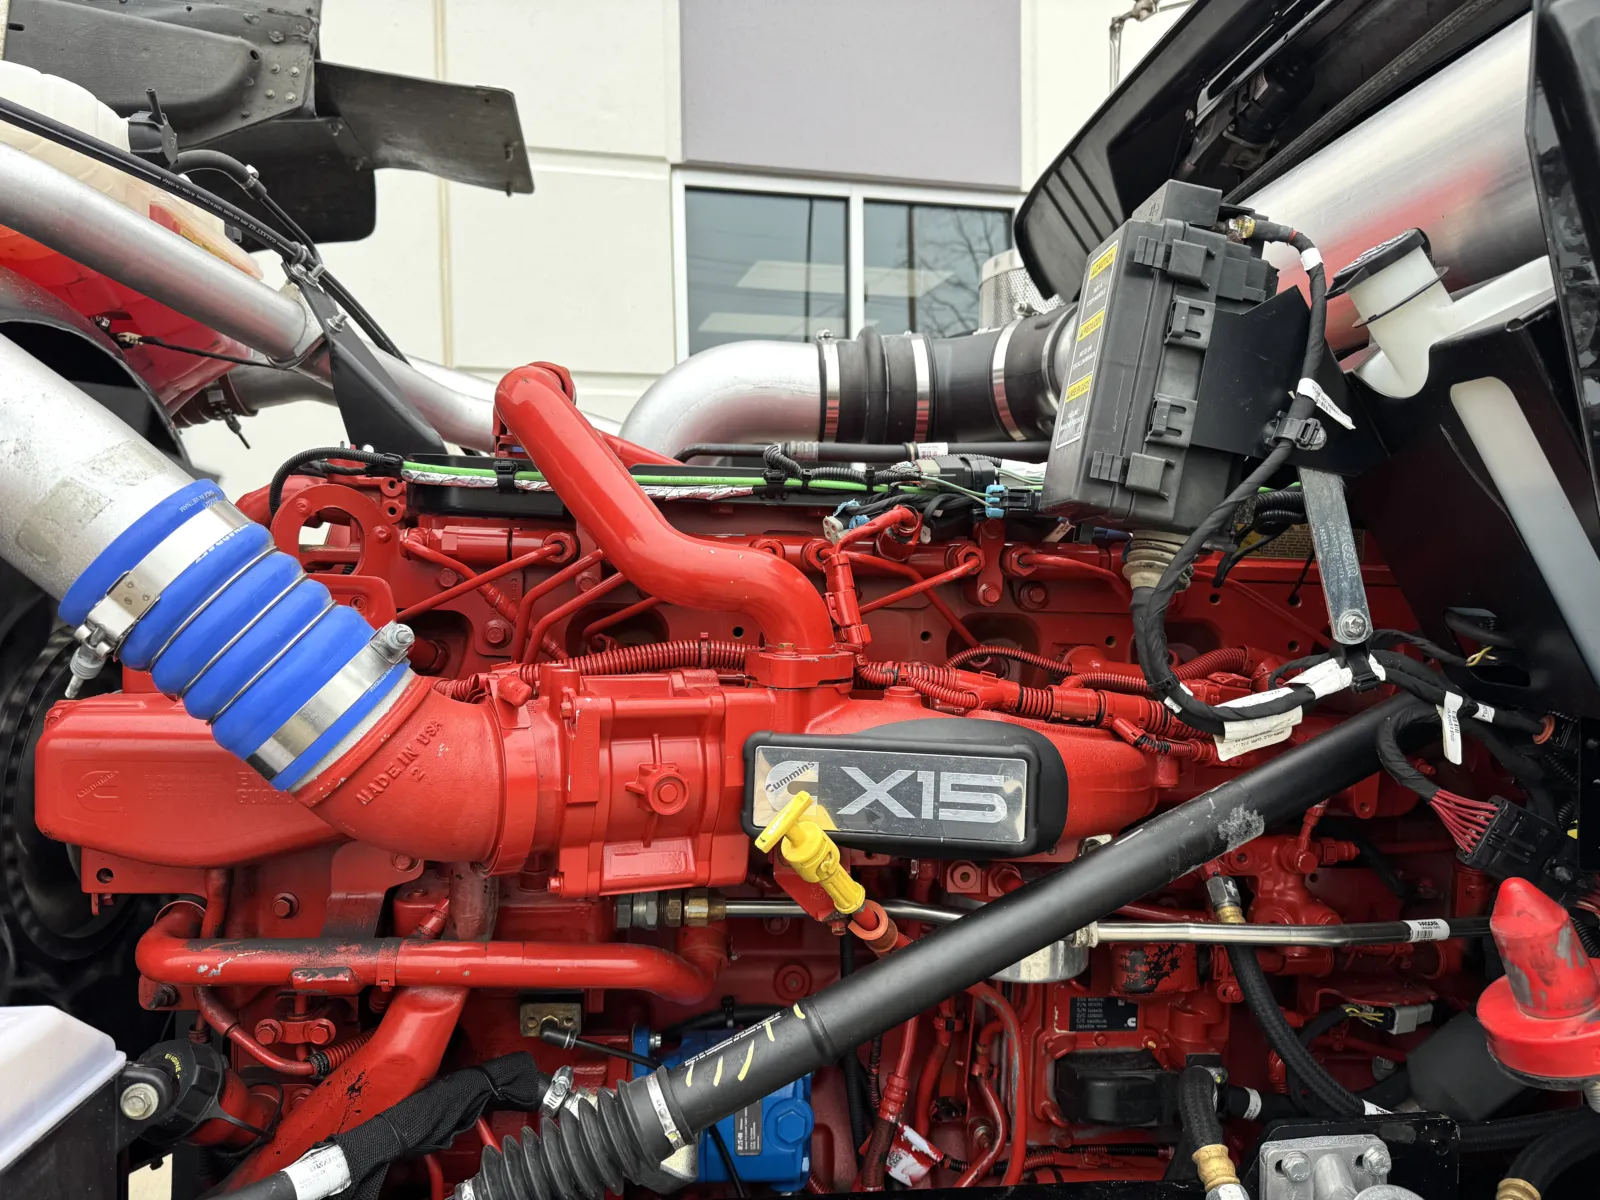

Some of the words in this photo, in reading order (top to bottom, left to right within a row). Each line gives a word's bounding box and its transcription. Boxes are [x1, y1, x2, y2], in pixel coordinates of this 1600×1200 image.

[178, 495, 200, 512] VIETNAM
[356, 762, 402, 805] MADE
[397, 743, 419, 766] IN
[416, 721, 442, 746] USA
[411, 766, 425, 781] 2
[765, 761, 815, 793] Cummins
[836, 766, 1007, 824] X15
[163, 1052, 181, 1072] ENGINE
